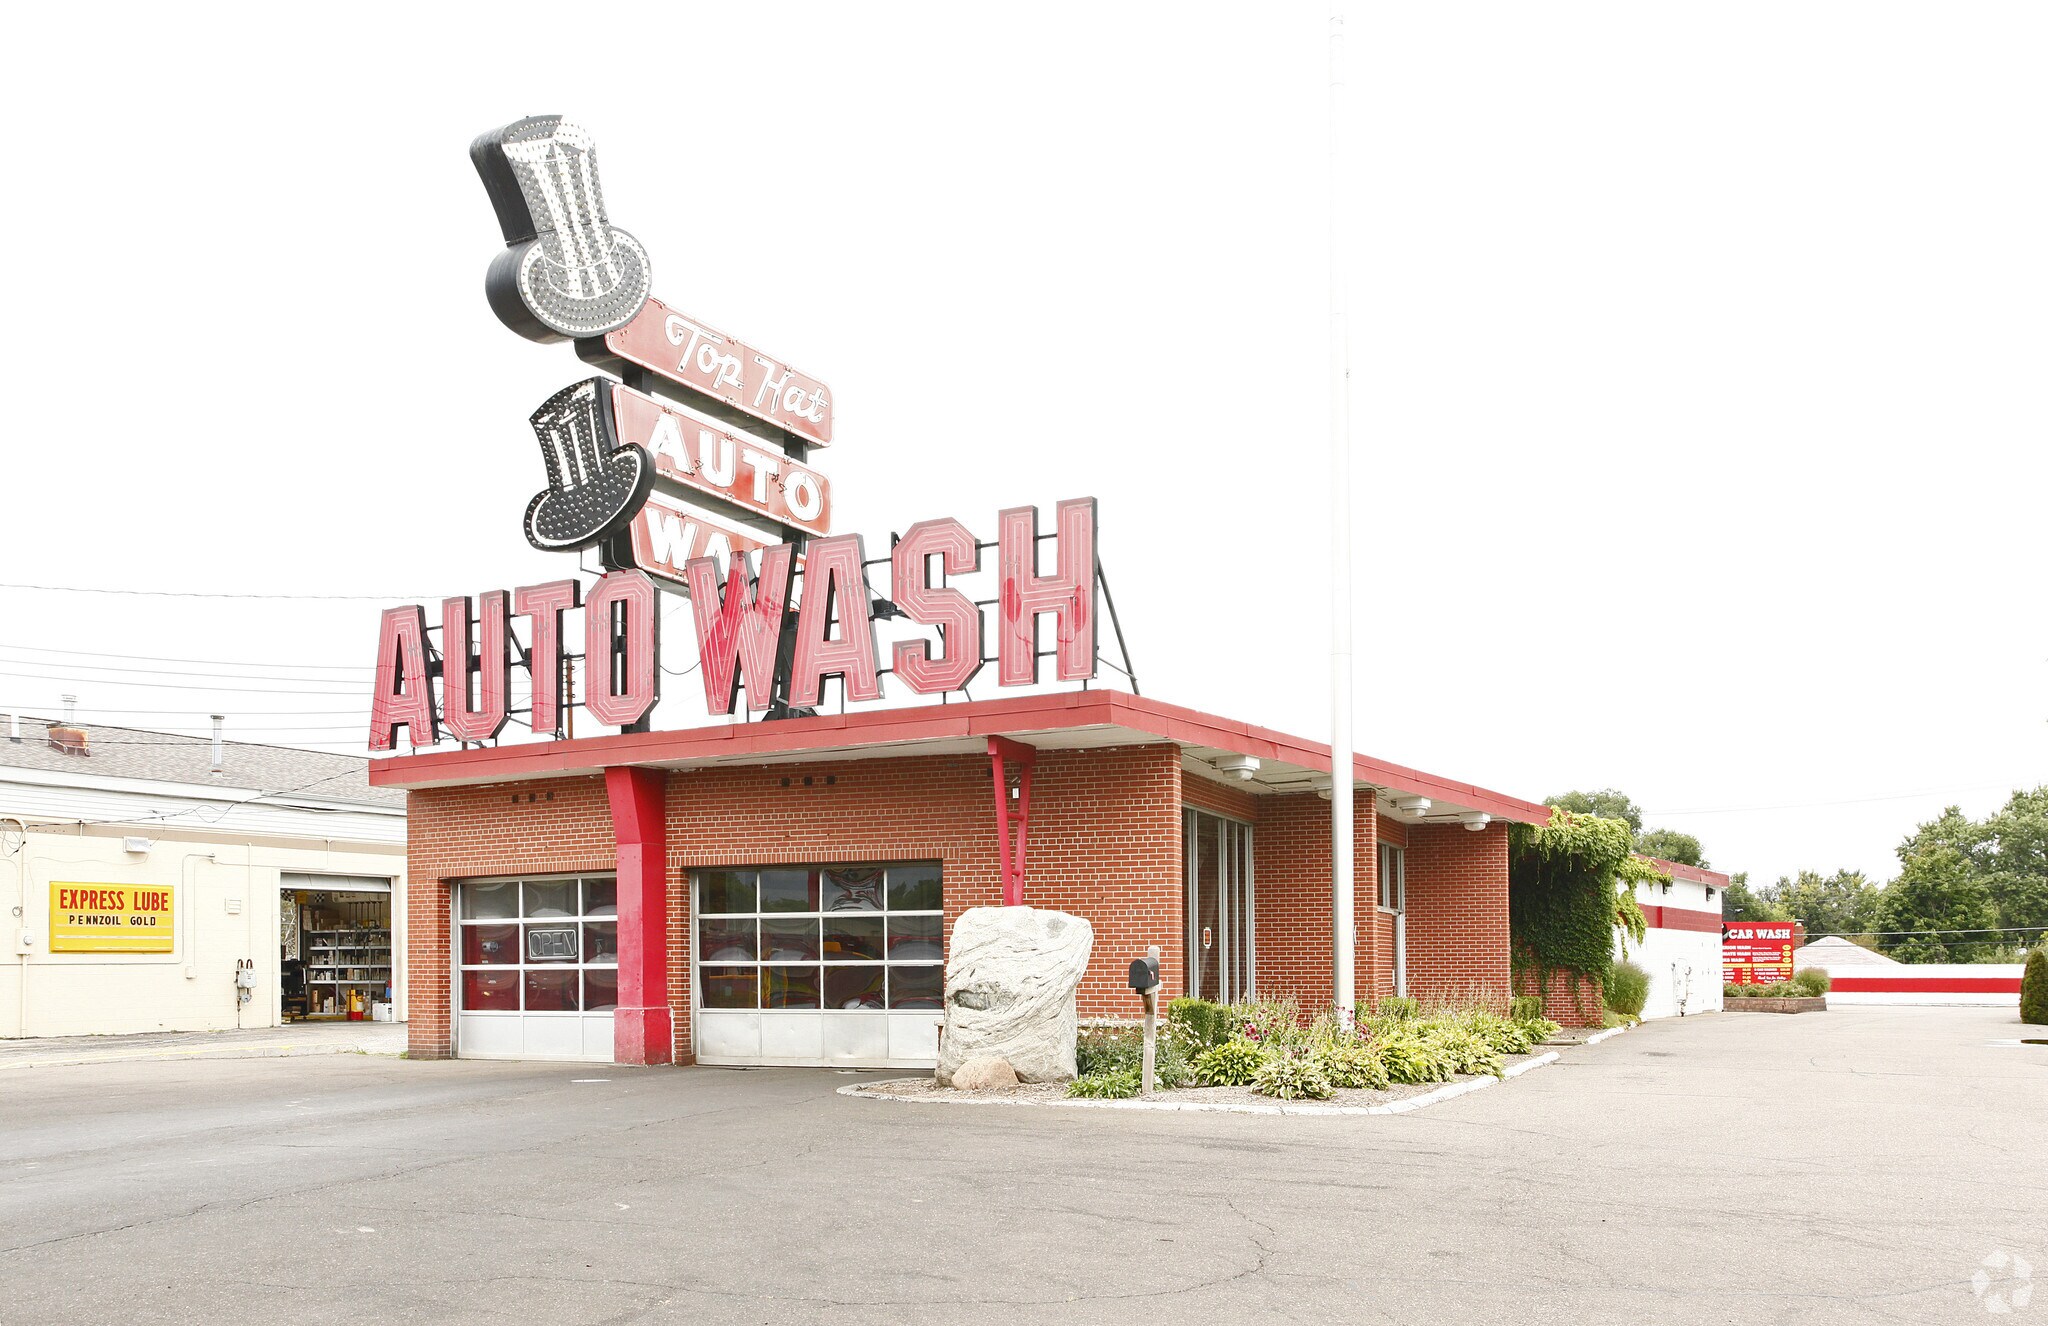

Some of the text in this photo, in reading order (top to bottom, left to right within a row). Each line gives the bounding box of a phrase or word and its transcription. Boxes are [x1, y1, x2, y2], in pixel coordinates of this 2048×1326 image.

[664, 313, 829, 424] Top Hat
[646, 411, 824, 522] AUTO
[367, 497, 1099, 752] AUTO WASH
[60, 889, 169, 911] EXPRESS LUBE
[69, 915, 156, 926] PENNZOIL GOLD
[531, 933, 574, 955] OPEN
[1728, 929, 1791, 939] CAR WASH
